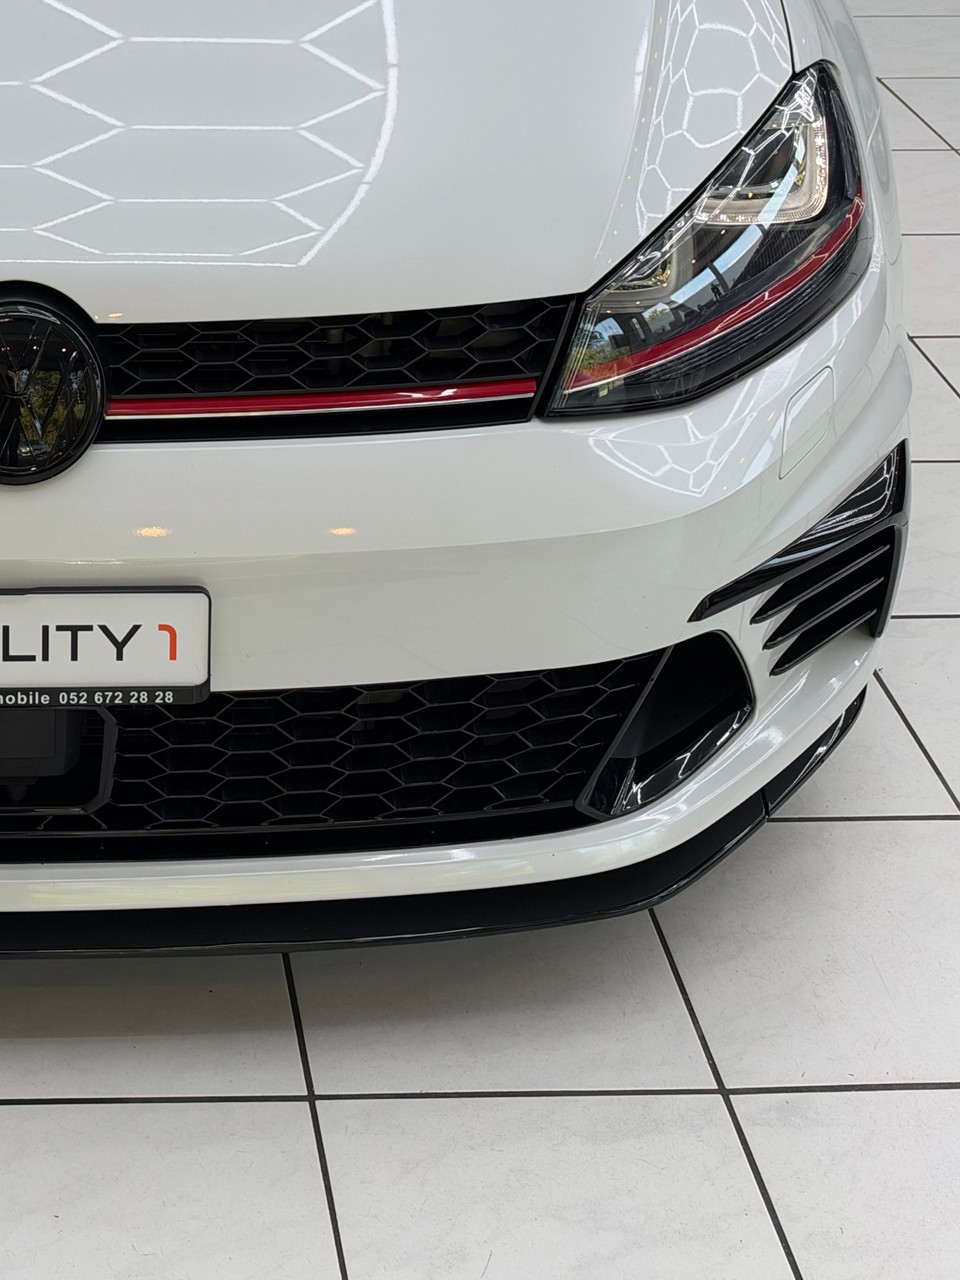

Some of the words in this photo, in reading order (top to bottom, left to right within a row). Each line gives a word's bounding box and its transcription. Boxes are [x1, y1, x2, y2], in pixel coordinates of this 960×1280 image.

[157, 623, 178, 661] 1
[58, 691, 89, 705] 052
[94, 691, 123, 705] 672
[128, 691, 149, 705] 28
[154, 690, 175, 704] 28
